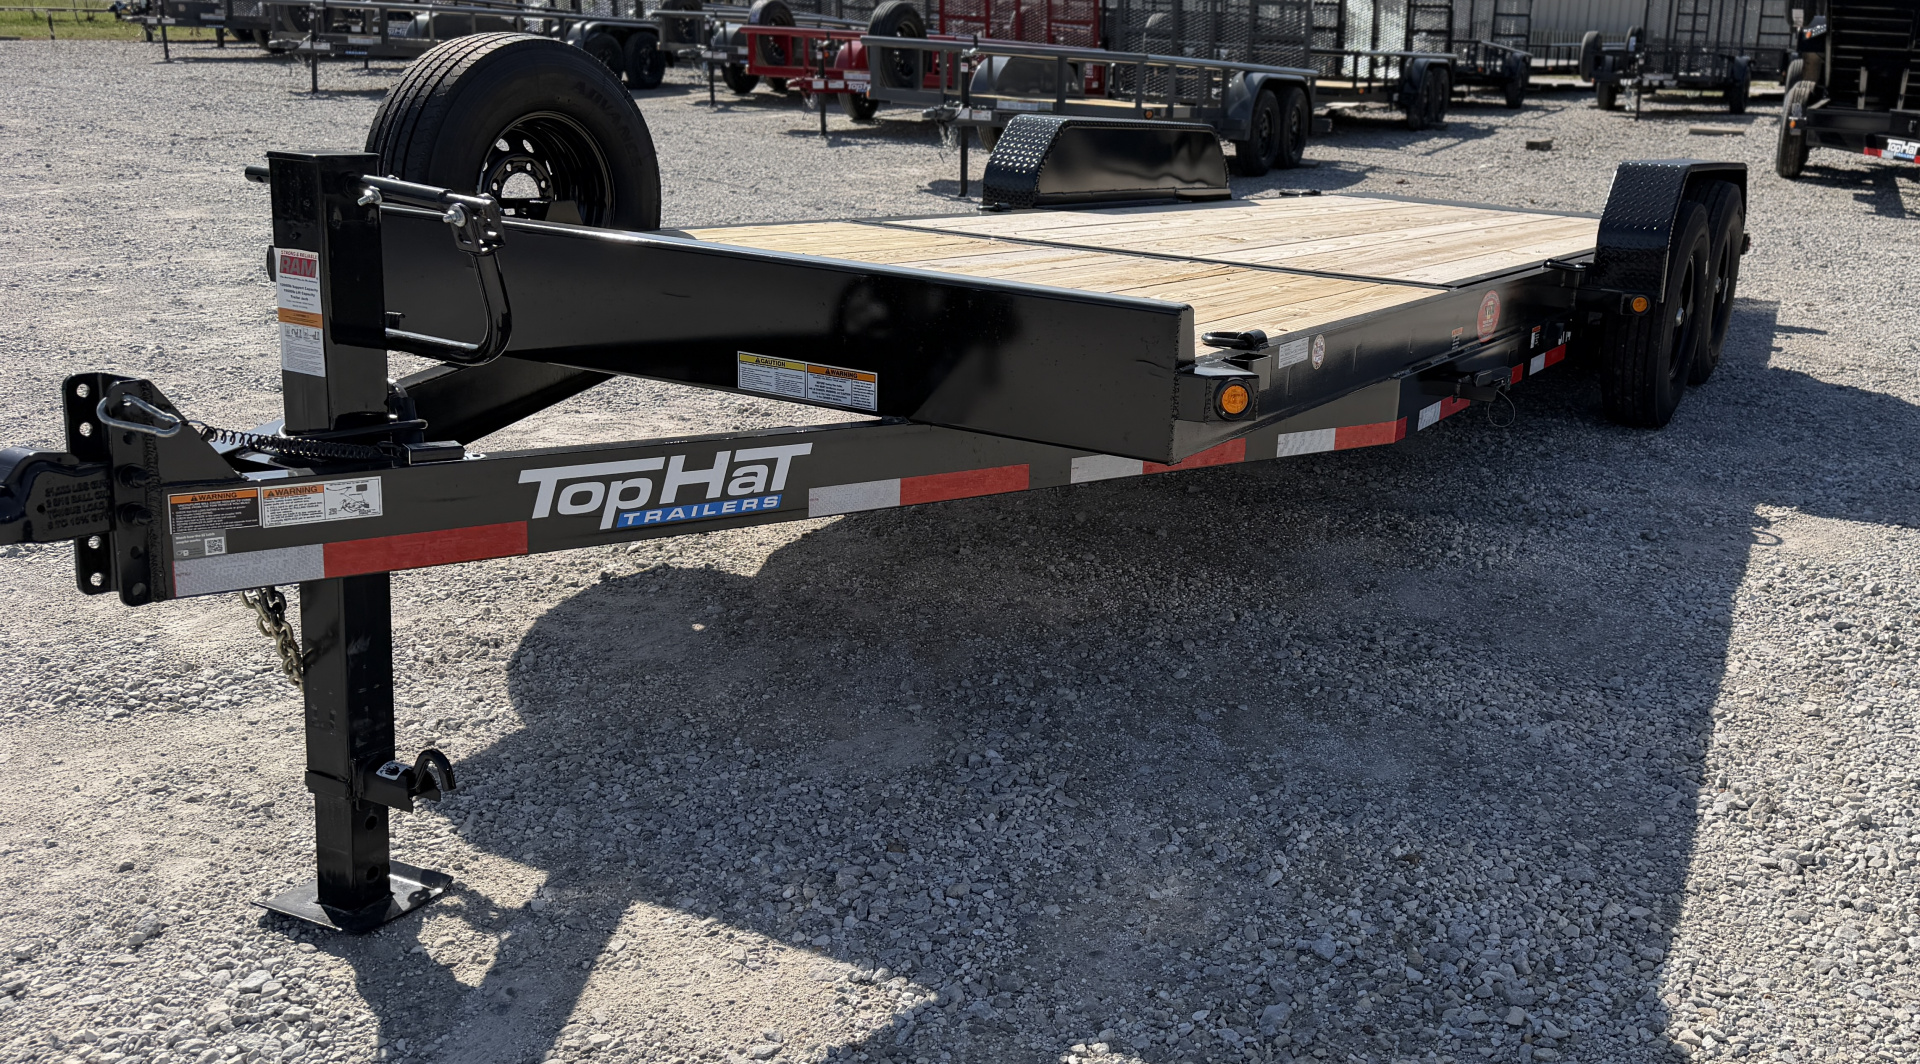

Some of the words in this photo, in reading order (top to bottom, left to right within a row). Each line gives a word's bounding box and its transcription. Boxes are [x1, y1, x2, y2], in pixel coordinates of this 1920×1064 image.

[280, 256, 317, 278] RAM
[760, 358, 786, 368] CAUTION
[830, 369, 858, 379] WARNING
[274, 485, 318, 496] WARNING
[198, 492, 238, 501] WARNING
[623, 495, 780, 525] TRAILERS
